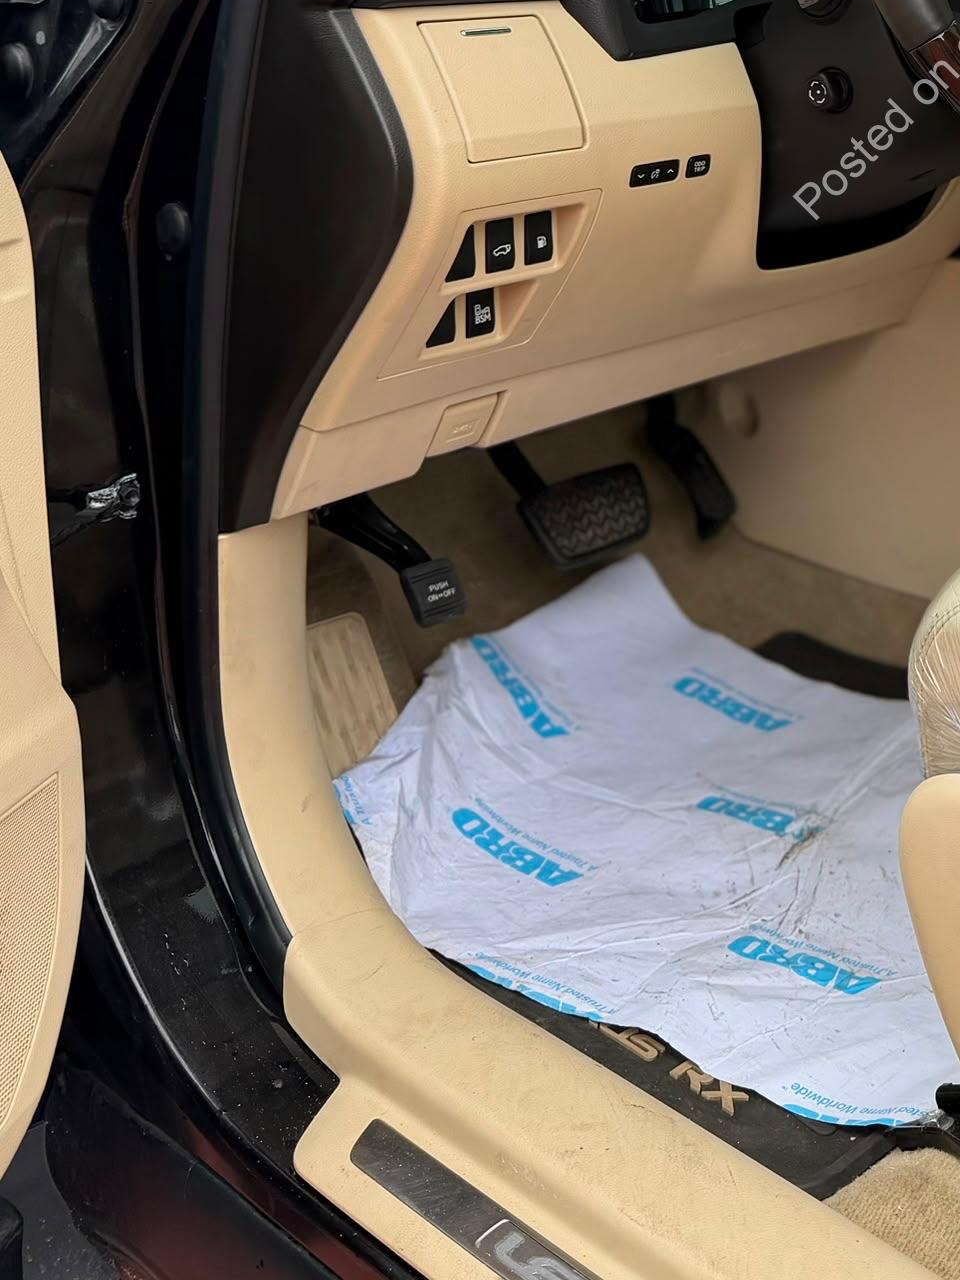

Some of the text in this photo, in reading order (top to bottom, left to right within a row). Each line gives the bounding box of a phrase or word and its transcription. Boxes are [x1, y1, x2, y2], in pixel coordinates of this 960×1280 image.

[475, 311, 491, 324] BSM
[429, 580, 449, 592] PUSH
[468, 635, 569, 738] ABRO
[672, 677, 793, 732] ABRO
[450, 807, 584, 888] ABRO
[519, 831, 551, 850] Name
[548, 846, 588, 868] Trusted
[726, 934, 880, 996] ABRO
[838, 955, 886, 975] Trusted
[531, 972, 565, 991] Name
[563, 986, 607, 1012] Trusted
[669, 1060, 749, 1116] RX
[790, 1081, 858, 1114] Worldwide
[858, 1106, 895, 1118] Name
